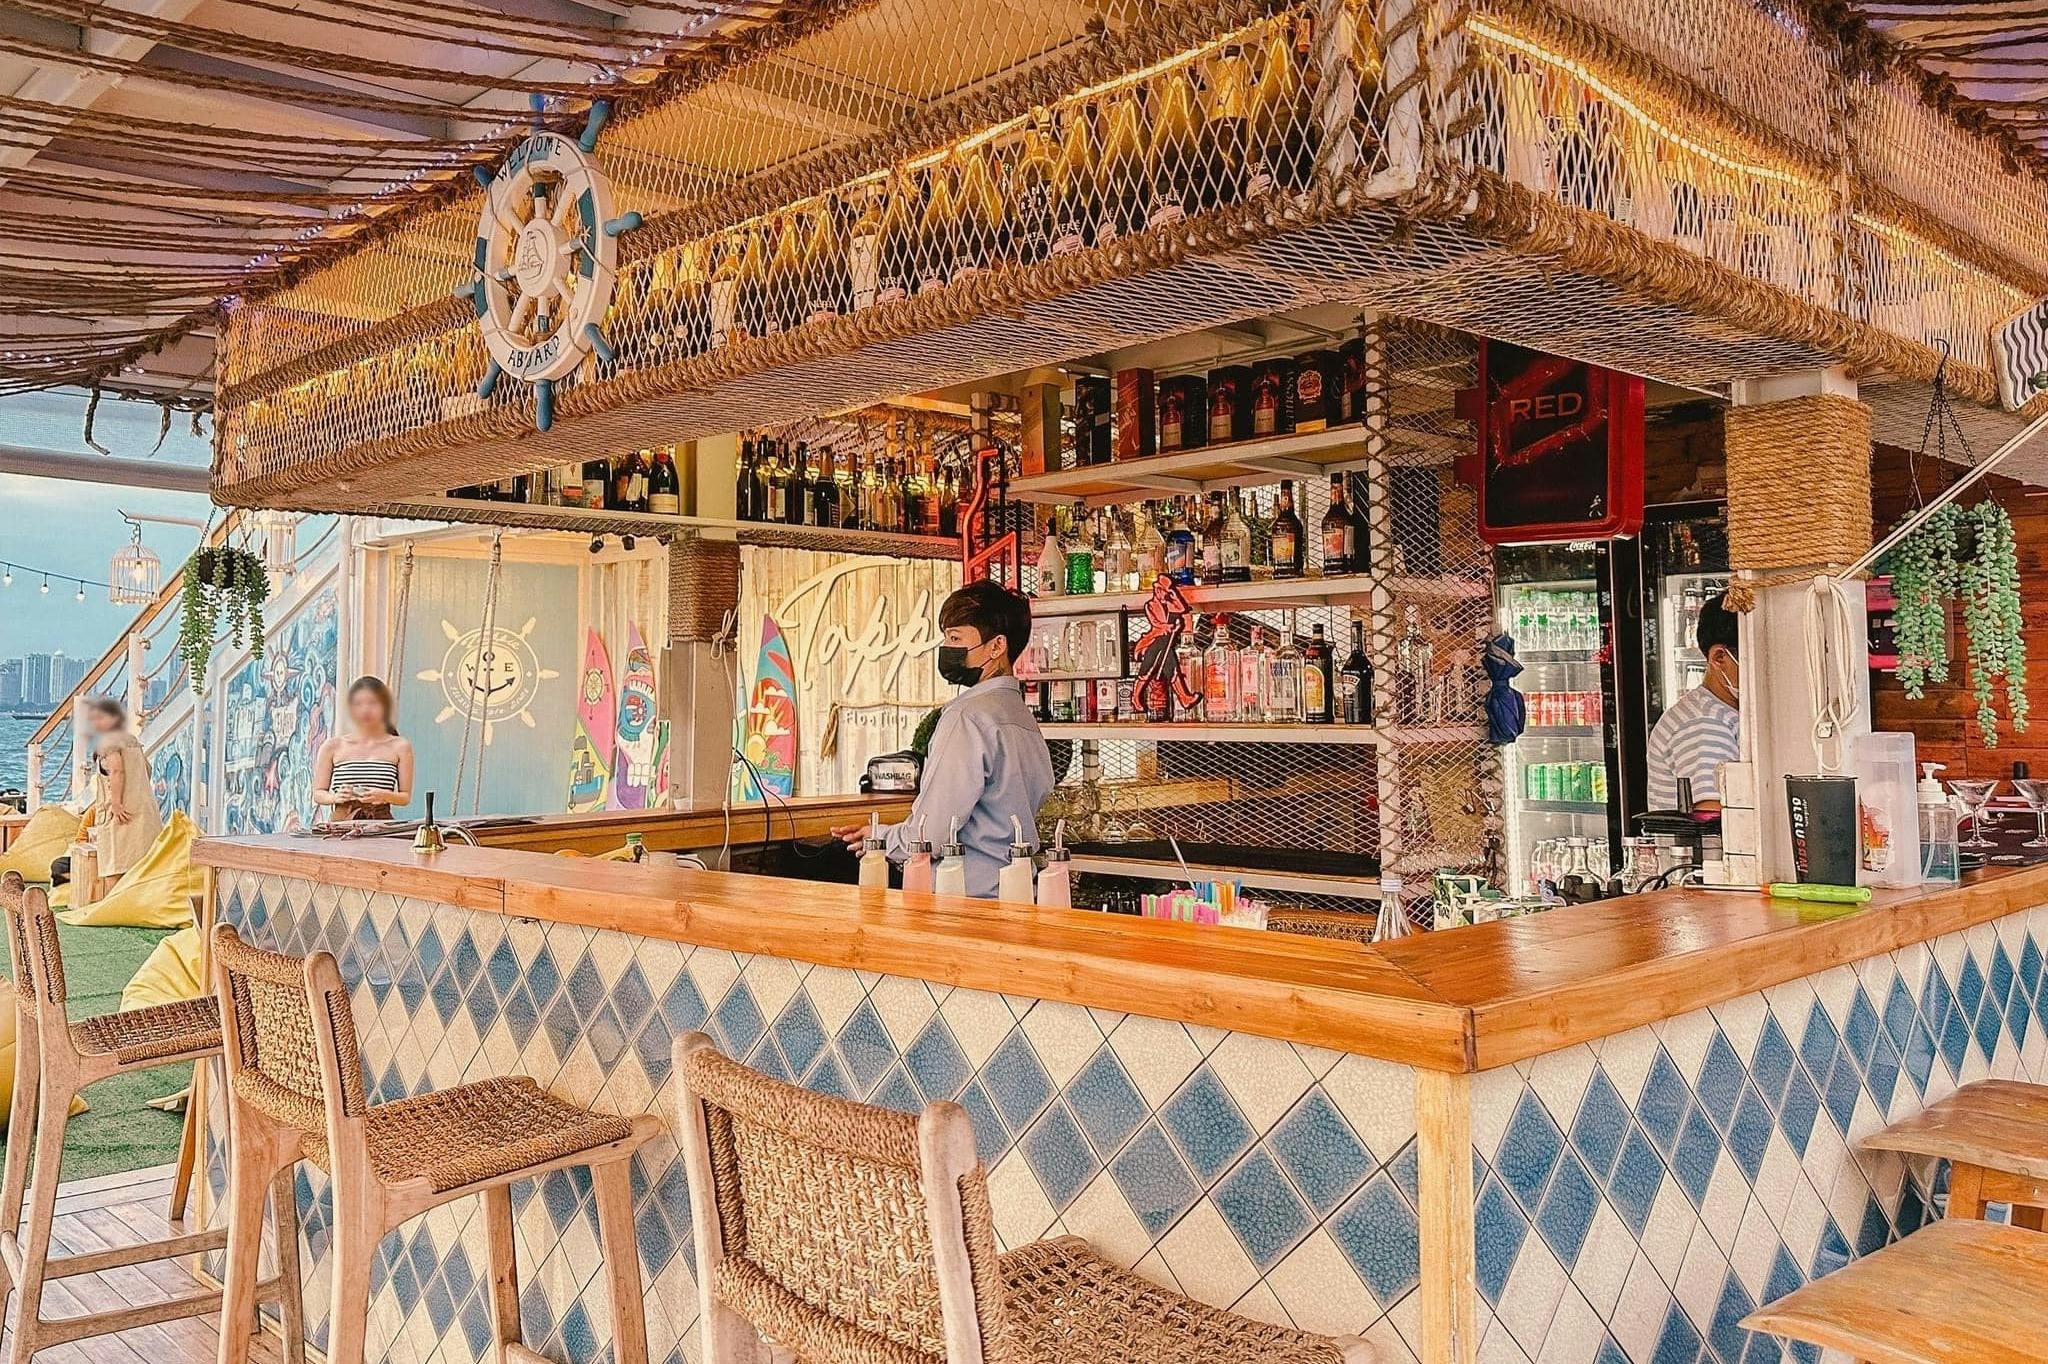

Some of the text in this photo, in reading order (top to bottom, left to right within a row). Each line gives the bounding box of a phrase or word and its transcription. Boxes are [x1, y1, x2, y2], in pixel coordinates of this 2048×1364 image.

[1510, 392, 1582, 421] RED
[504, 662, 514, 673] E
[846, 708, 908, 730] Floating
[873, 771, 912, 781] WASHBAG
